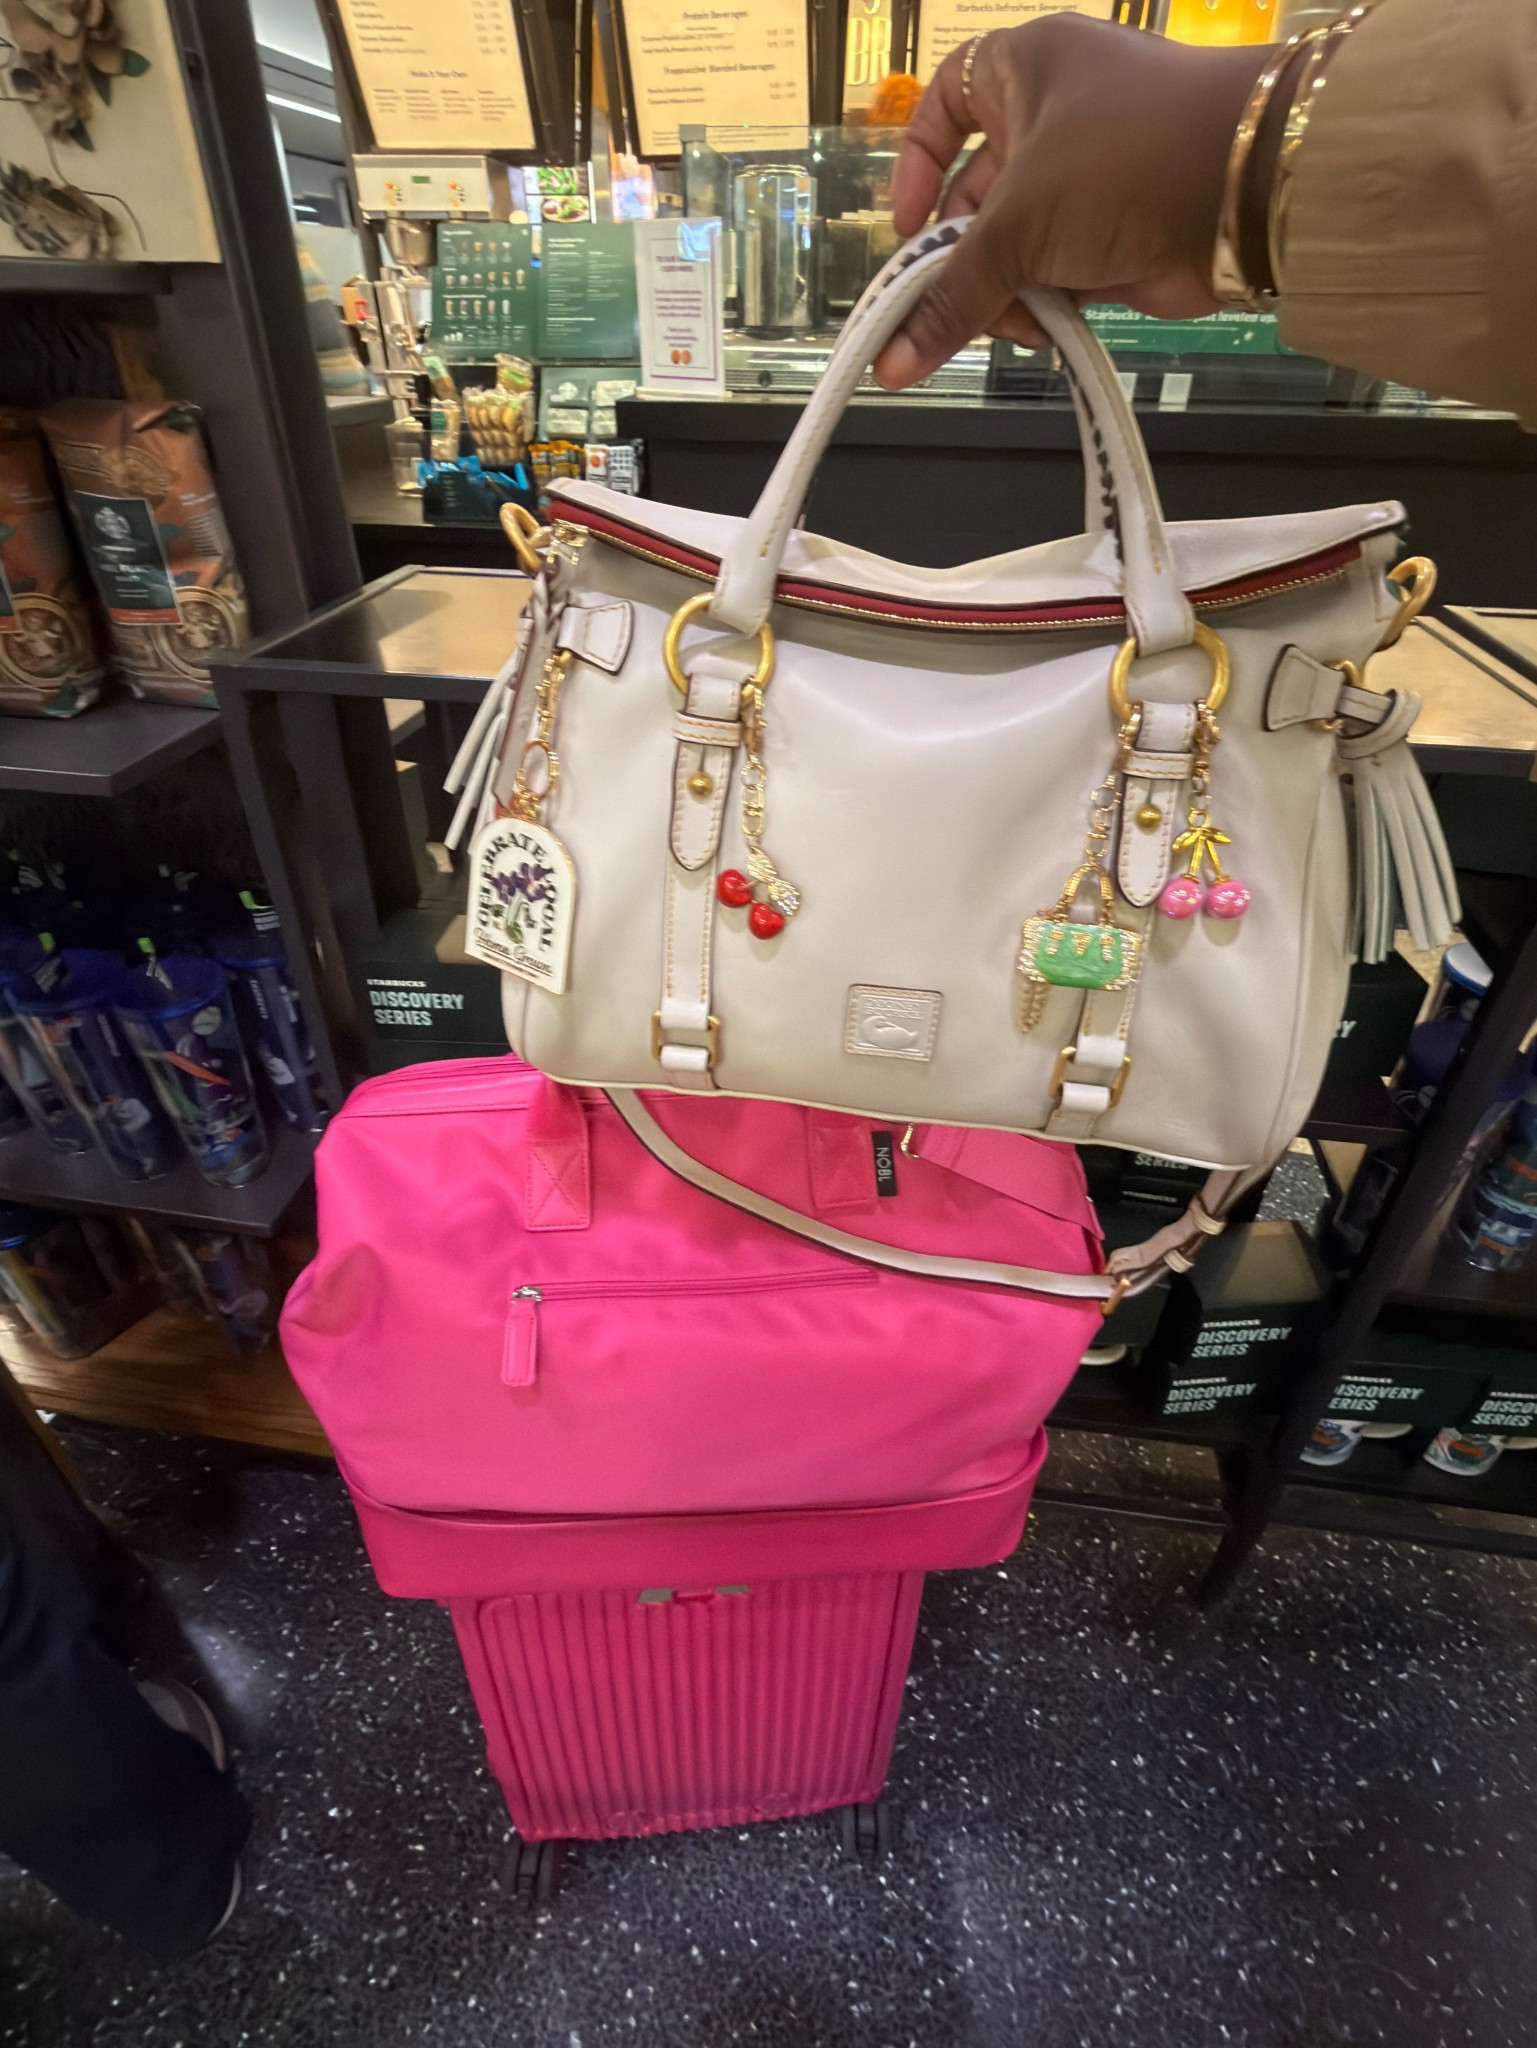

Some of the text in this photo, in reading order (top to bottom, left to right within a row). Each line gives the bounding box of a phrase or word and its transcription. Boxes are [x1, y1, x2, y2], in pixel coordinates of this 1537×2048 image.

[956, 3, 992, 12] Starbucks
[1085, 309, 1140, 321] Starbucks
[369, 990, 465, 1010] DISCOVERY
[373, 1008, 433, 1026] SERIES
[875, 1146, 894, 1183] NOBL
[1196, 1326, 1293, 1344] DISCOVERY
[1191, 1343, 1250, 1358] SERIES
[1166, 1382, 1257, 1401] DISCOVERY
[1334, 1383, 1425, 1400] ISCOVERY
[1163, 1398, 1218, 1415] SERIES
[1327, 1397, 1380, 1412] ERIES
[1479, 1399, 1537, 1415] DISCO
[1471, 1412, 1534, 1427] SERIES
